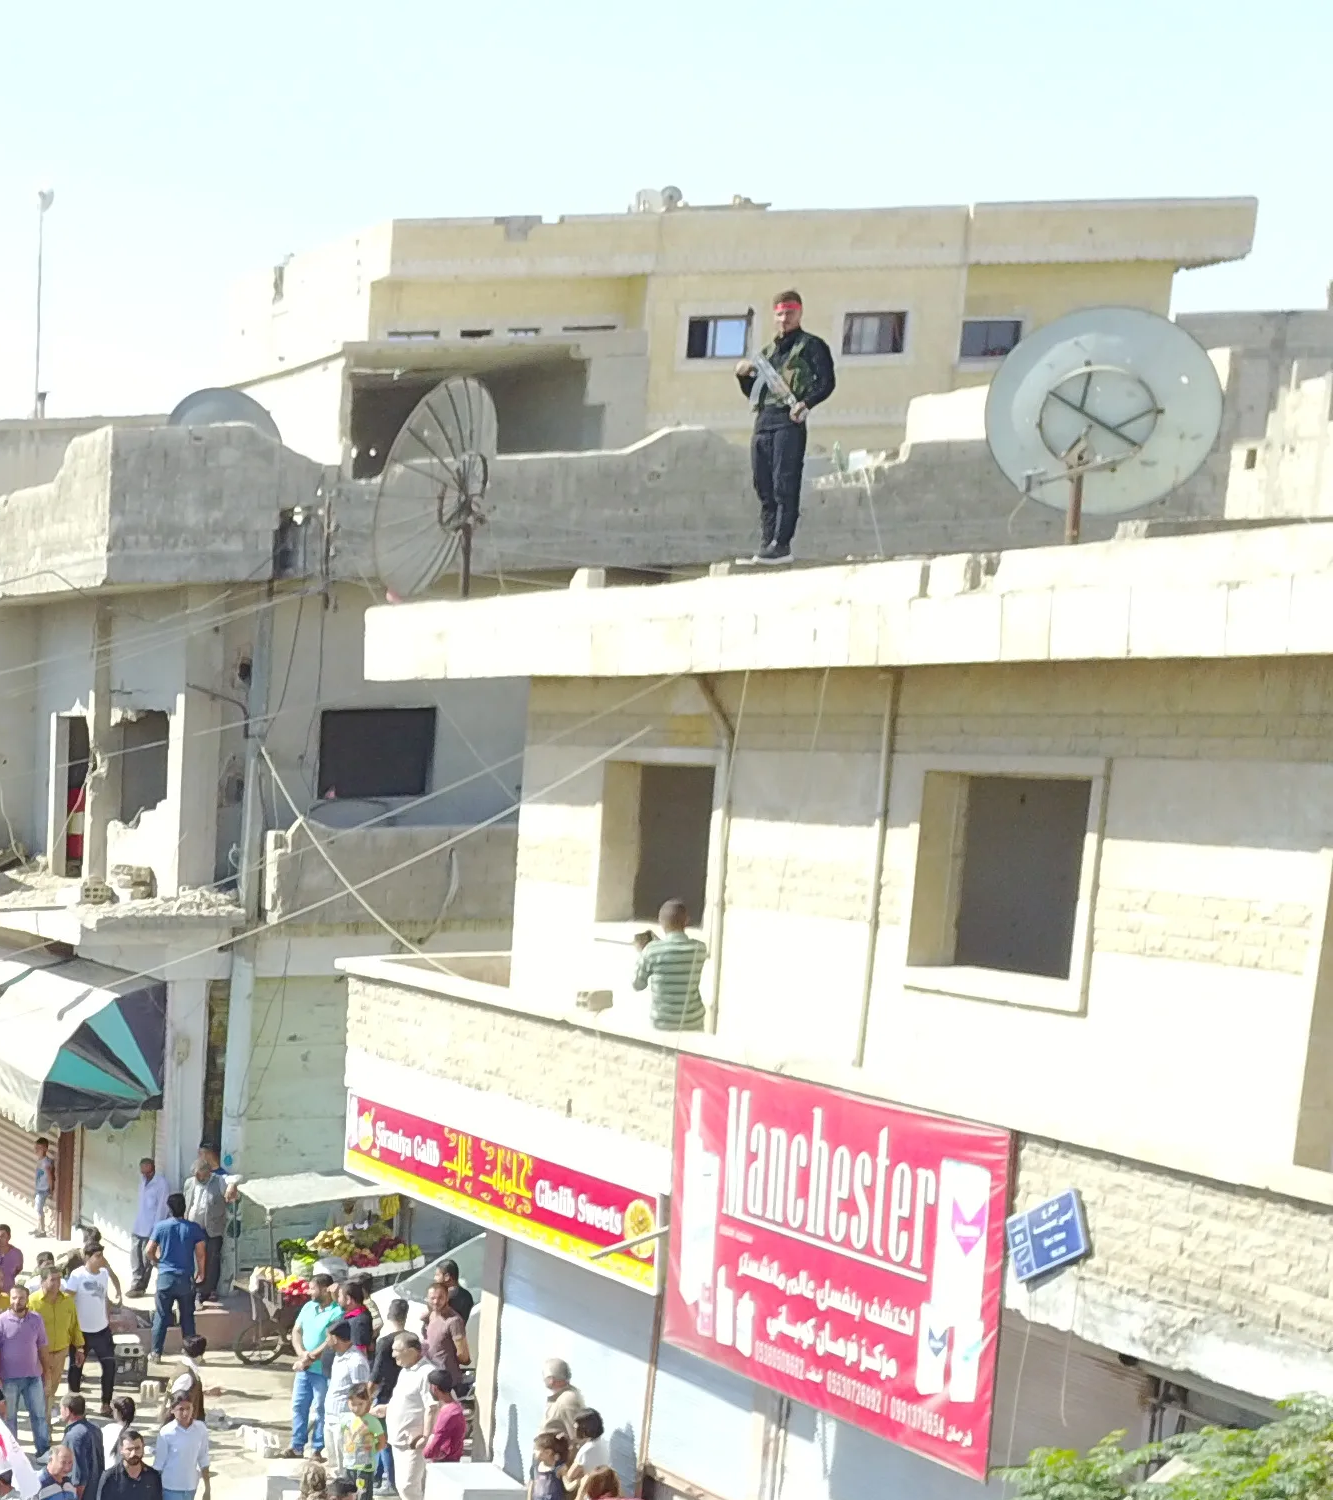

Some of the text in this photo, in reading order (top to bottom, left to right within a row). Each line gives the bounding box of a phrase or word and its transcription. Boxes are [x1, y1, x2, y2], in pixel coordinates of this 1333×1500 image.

[414, 1134, 440, 1168] Galib
[721, 1087, 936, 1268] Manchester
[535, 1179, 622, 1235] Ghalib Sweets
[860, 1338, 898, 1380] مركز
